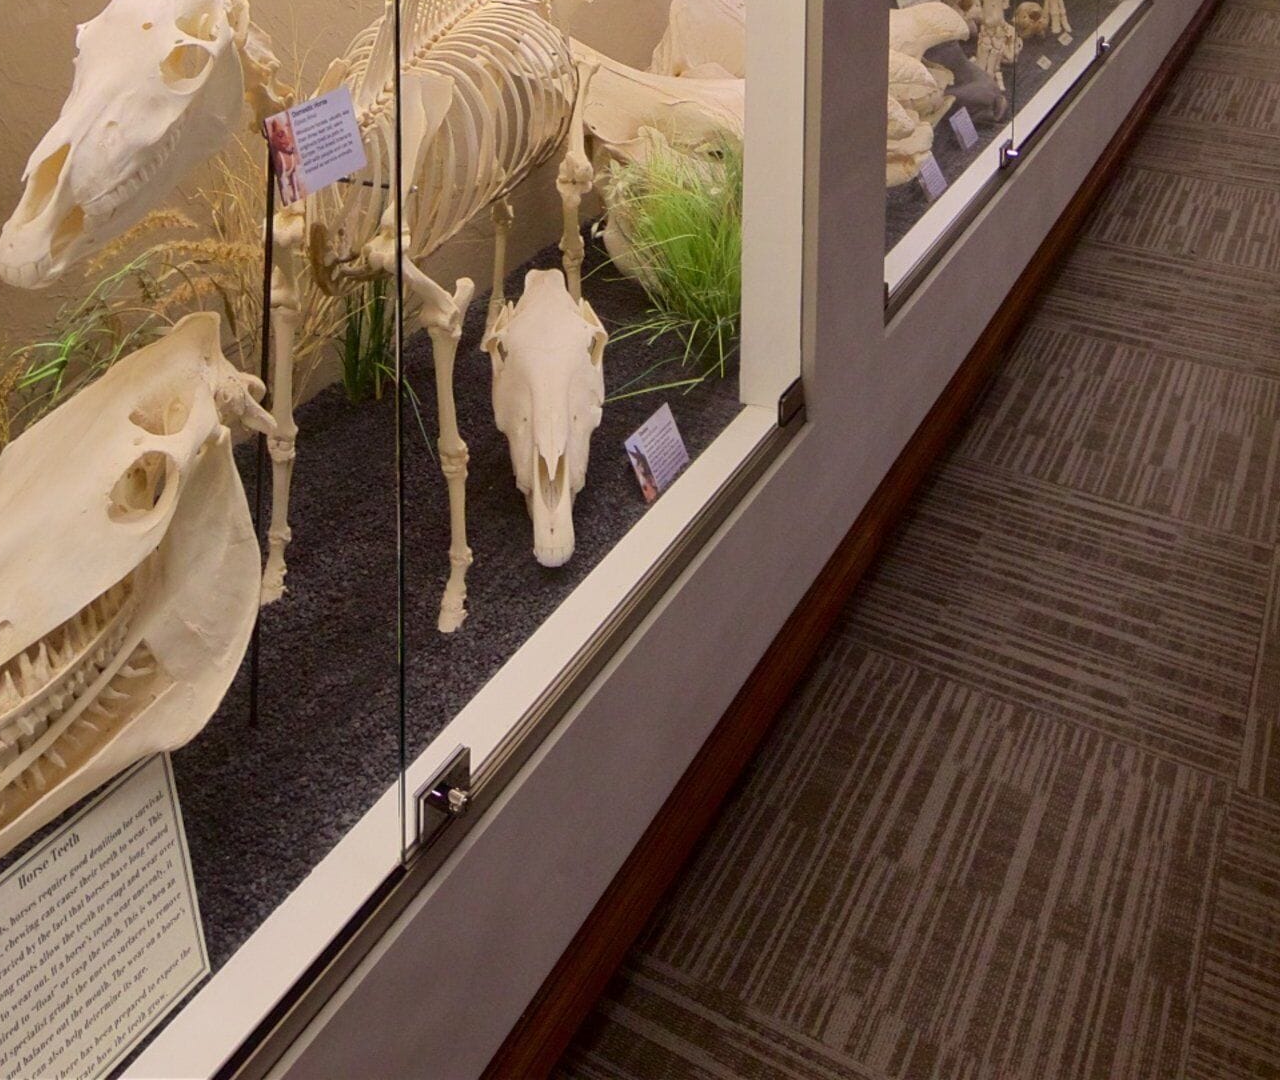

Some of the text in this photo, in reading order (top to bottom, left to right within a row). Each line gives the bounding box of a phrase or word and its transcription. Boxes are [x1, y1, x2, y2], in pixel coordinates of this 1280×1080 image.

[4, 918, 39, 951] chewing
[40, 905, 55, 920] can
[56, 886, 78, 907] cause
[78, 868, 97, 887] their
[98, 850, 117, 870] teeth
[148, 812, 162, 826] This
[9, 901, 36, 925] horses
[38, 874, 67, 902] require
[69, 854, 88, 877] good
[89, 828, 121, 858] dentition
[122, 816, 133, 830] for
[15, 964, 37, 985] roots
[39, 944, 59, 965] allow
[61, 930, 75, 944] the
[75, 910, 95, 931] teeth
[106, 882, 126, 904] erupt
[126, 868, 140, 886] and
[141, 854, 157, 872] wear
[158, 839, 174, 856] over
[18, 833, 79, 889] Horse Teeth
[37, 929, 51, 944] the
[52, 914, 67, 931] fact
[68, 899, 84, 917] that
[84, 879, 109, 902] horses
[110, 862, 127, 880] have
[128, 846, 145, 864] long
[145, 824, 168, 849] rooted
[9, 1017, 47, 1055] specialist
[48, 994, 73, 1022] grinds
[74, 980, 87, 995] the
[89, 954, 116, 982] uneven
[116, 926, 146, 954] surfaces
[155, 892, 180, 919] remove
[11, 989, 31, 1010] wear
[92, 915, 112, 936] teeth
[113, 897, 130, 917] wear
[70, 960, 87, 979] rasp
[88, 947, 100, 961] the
[123, 912, 138, 928] This
[146, 886, 166, 906] when
